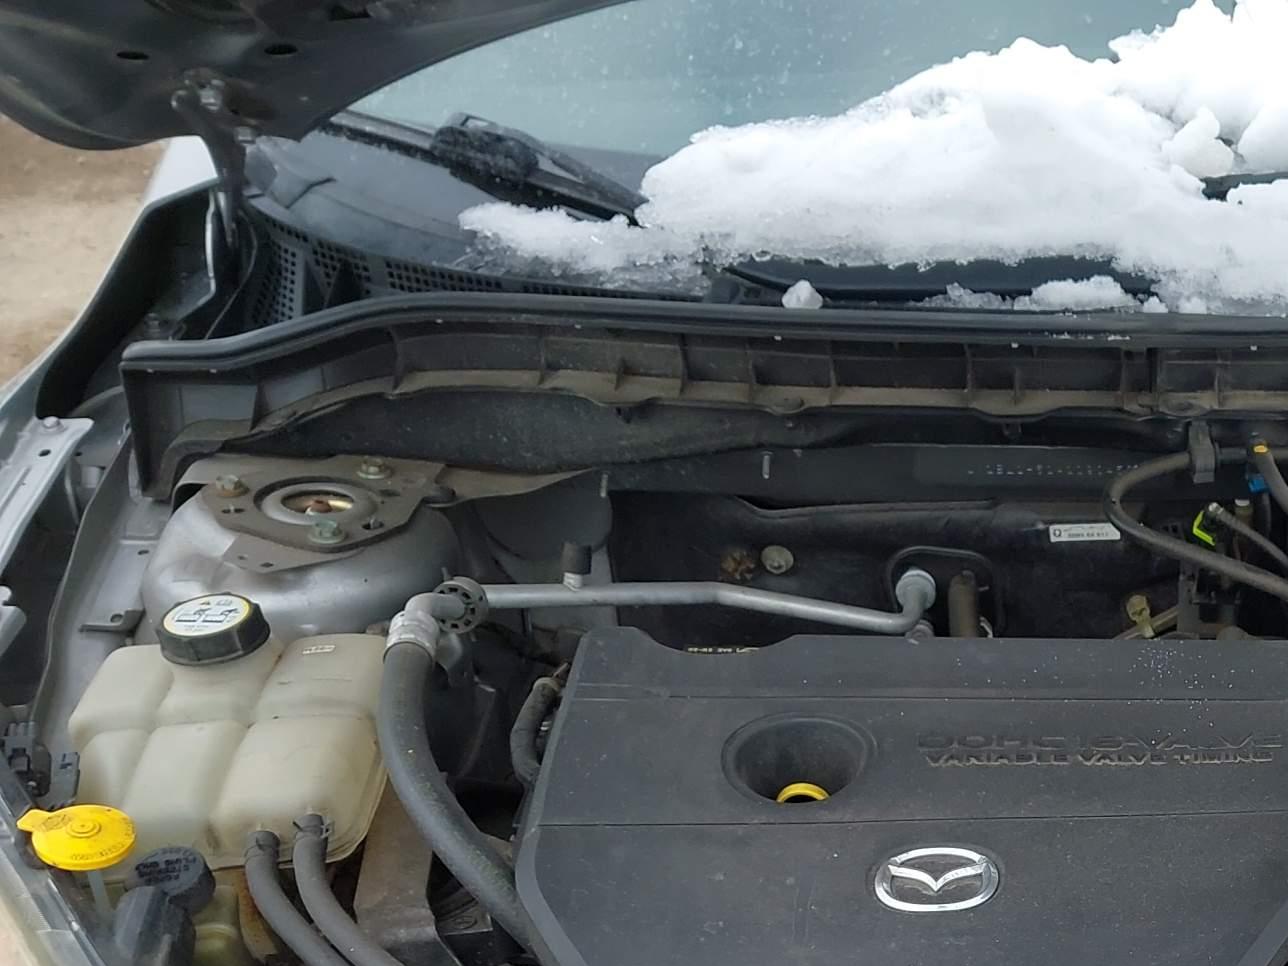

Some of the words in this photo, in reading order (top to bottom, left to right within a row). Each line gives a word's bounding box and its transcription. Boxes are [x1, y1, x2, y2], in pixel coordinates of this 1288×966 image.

[926, 751, 1071, 767] VARIABLE
[1078, 750, 1167, 766] VALVE
[1172, 750, 1273, 764] TIMING
